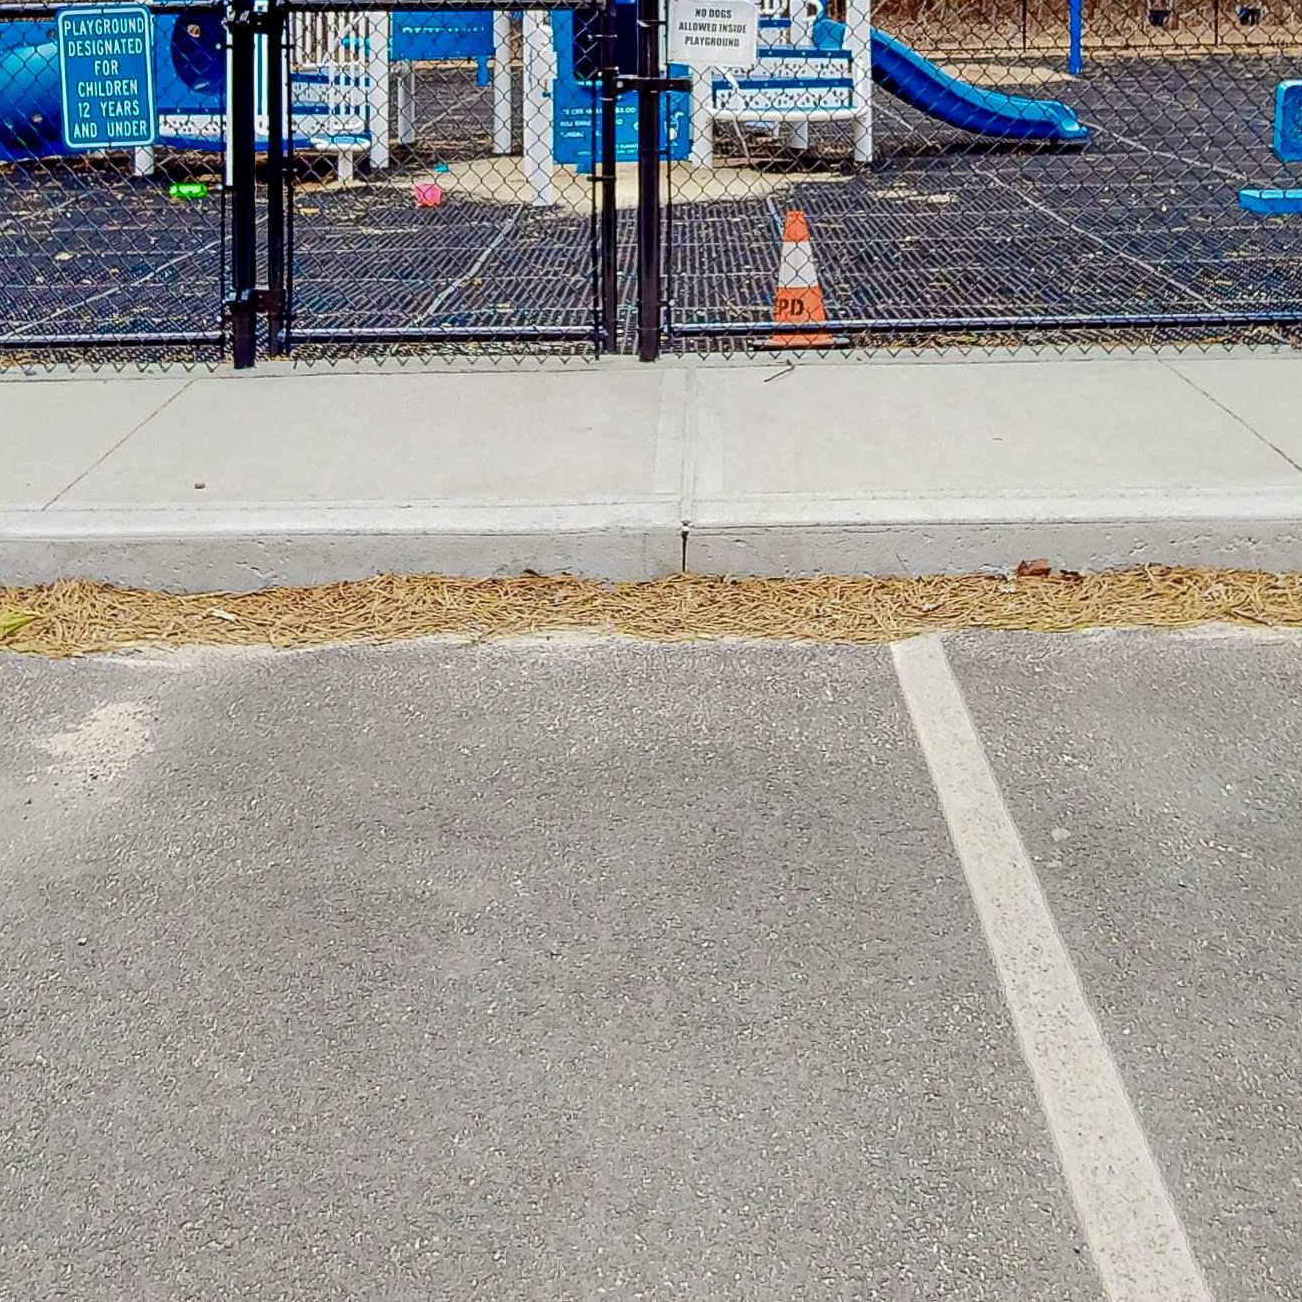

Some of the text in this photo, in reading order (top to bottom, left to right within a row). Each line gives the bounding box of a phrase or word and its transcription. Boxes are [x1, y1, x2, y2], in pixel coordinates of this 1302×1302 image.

[694, 8, 732, 19] NO DOGS
[64, 17, 145, 36] PLAYGROUND
[678, 21, 747, 34] ALLOWED INSIDE
[68, 38, 143, 57] DESIGNATED
[684, 36, 740, 47] PLAYGROUND
[94, 59, 119, 76] FOR
[78, 79, 138, 98] CHILDREN
[78, 100, 140, 118] 12 YEARS
[73, 120, 148, 139] AND UNDER
